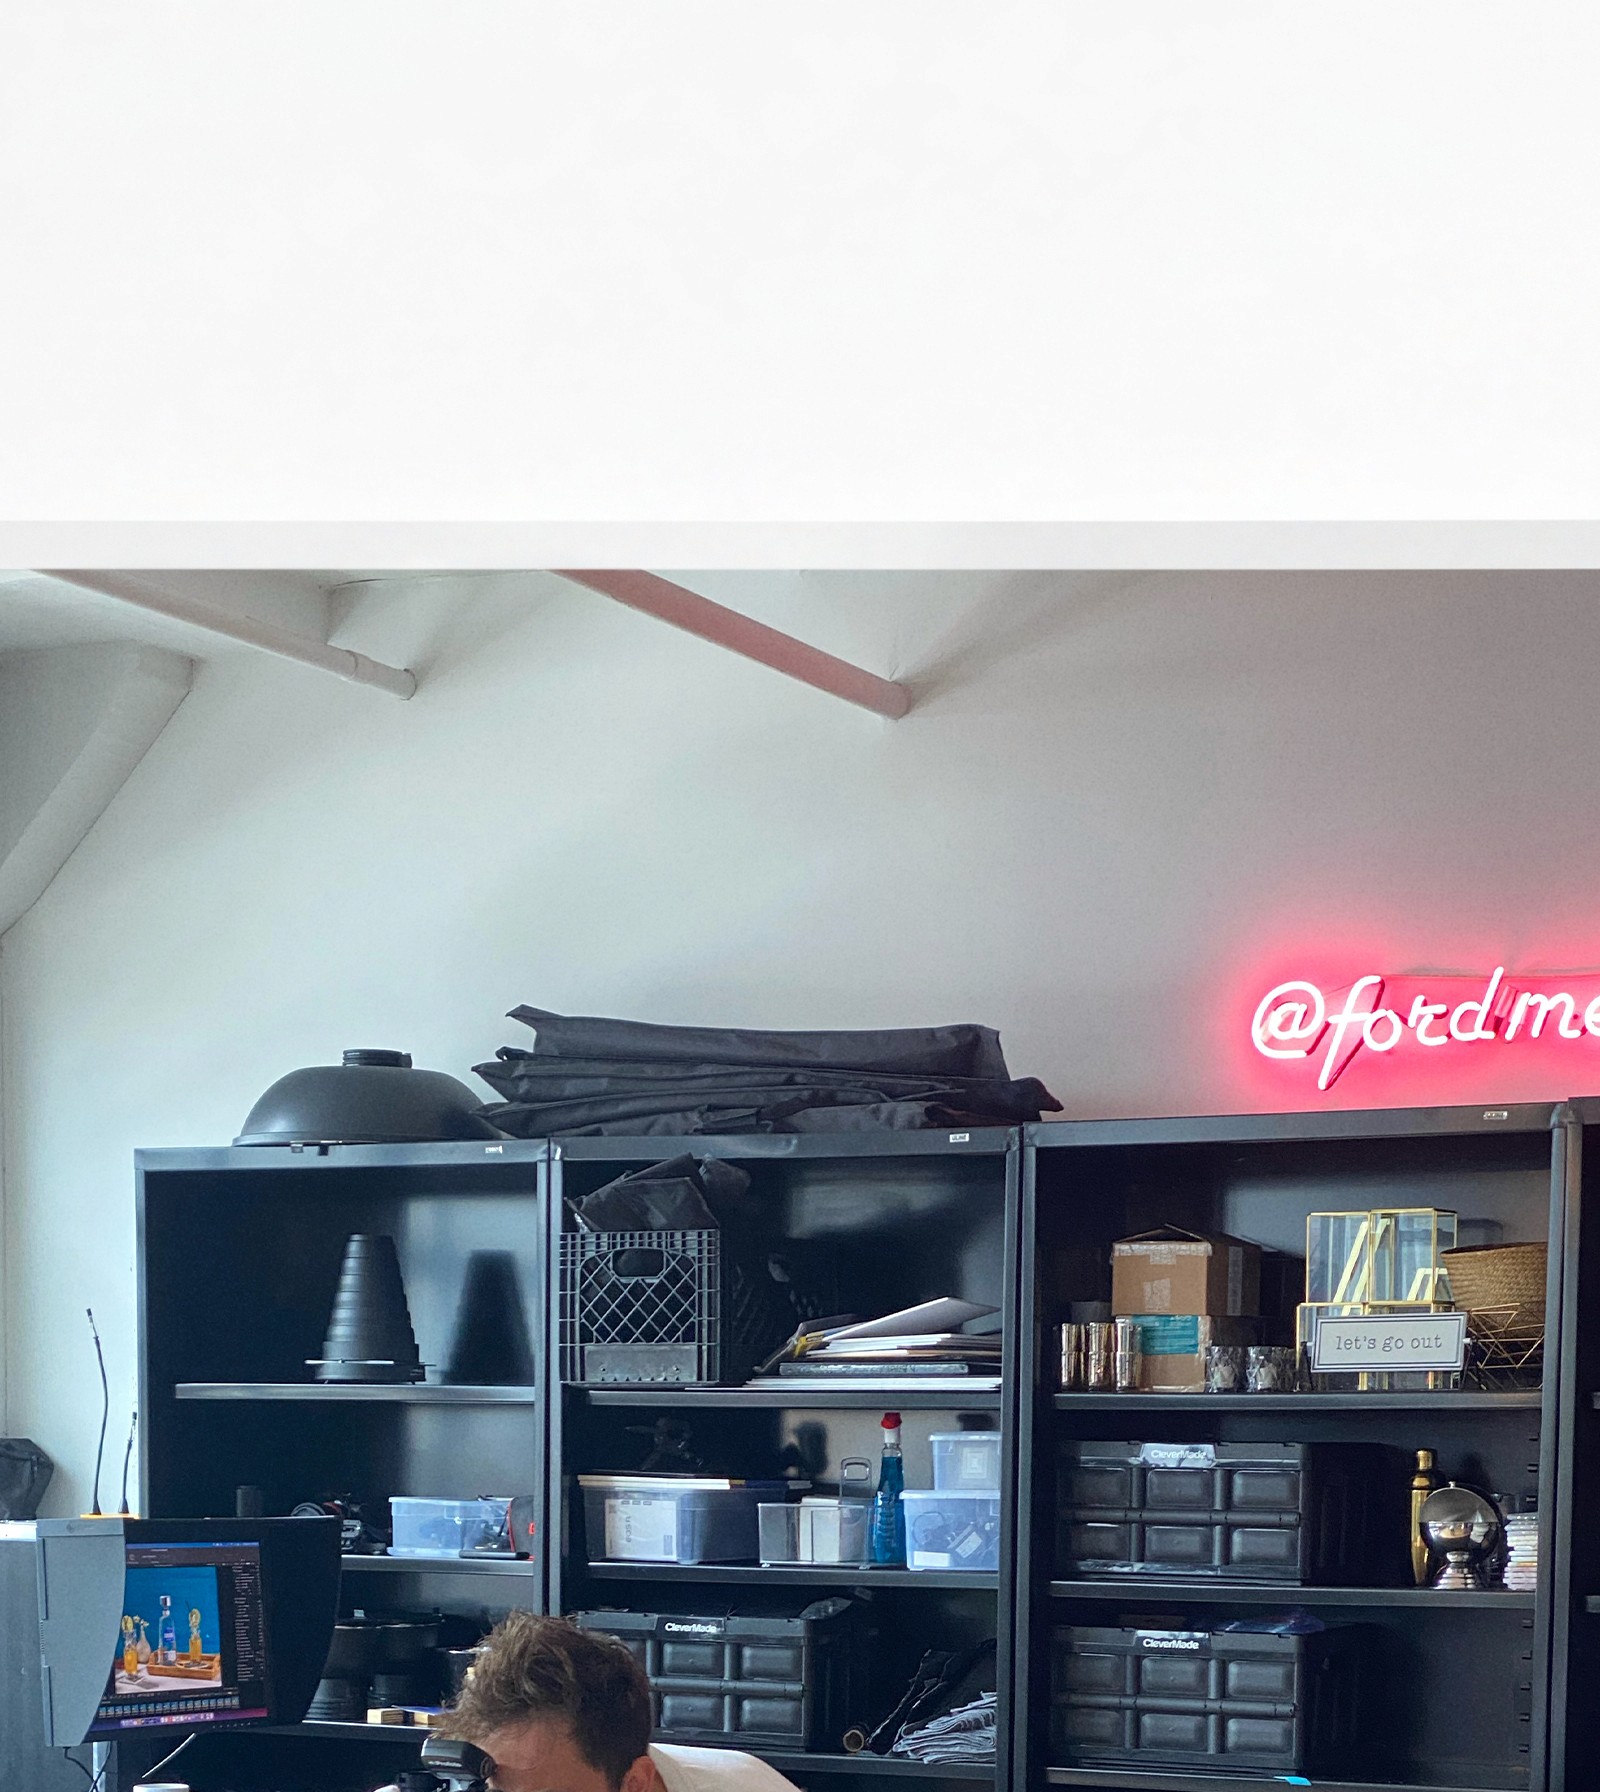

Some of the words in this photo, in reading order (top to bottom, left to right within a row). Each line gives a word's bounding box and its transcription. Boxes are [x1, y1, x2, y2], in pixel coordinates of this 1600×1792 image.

[1335, 1335, 1377, 1351] let's
[1381, 1335, 1405, 1353] go
[1410, 1334, 1443, 1350] out
[1150, 1449, 1207, 1460] CleverMade
[664, 1622, 717, 1633] CleverMade
[1142, 1638, 1199, 1650] CleverMade
